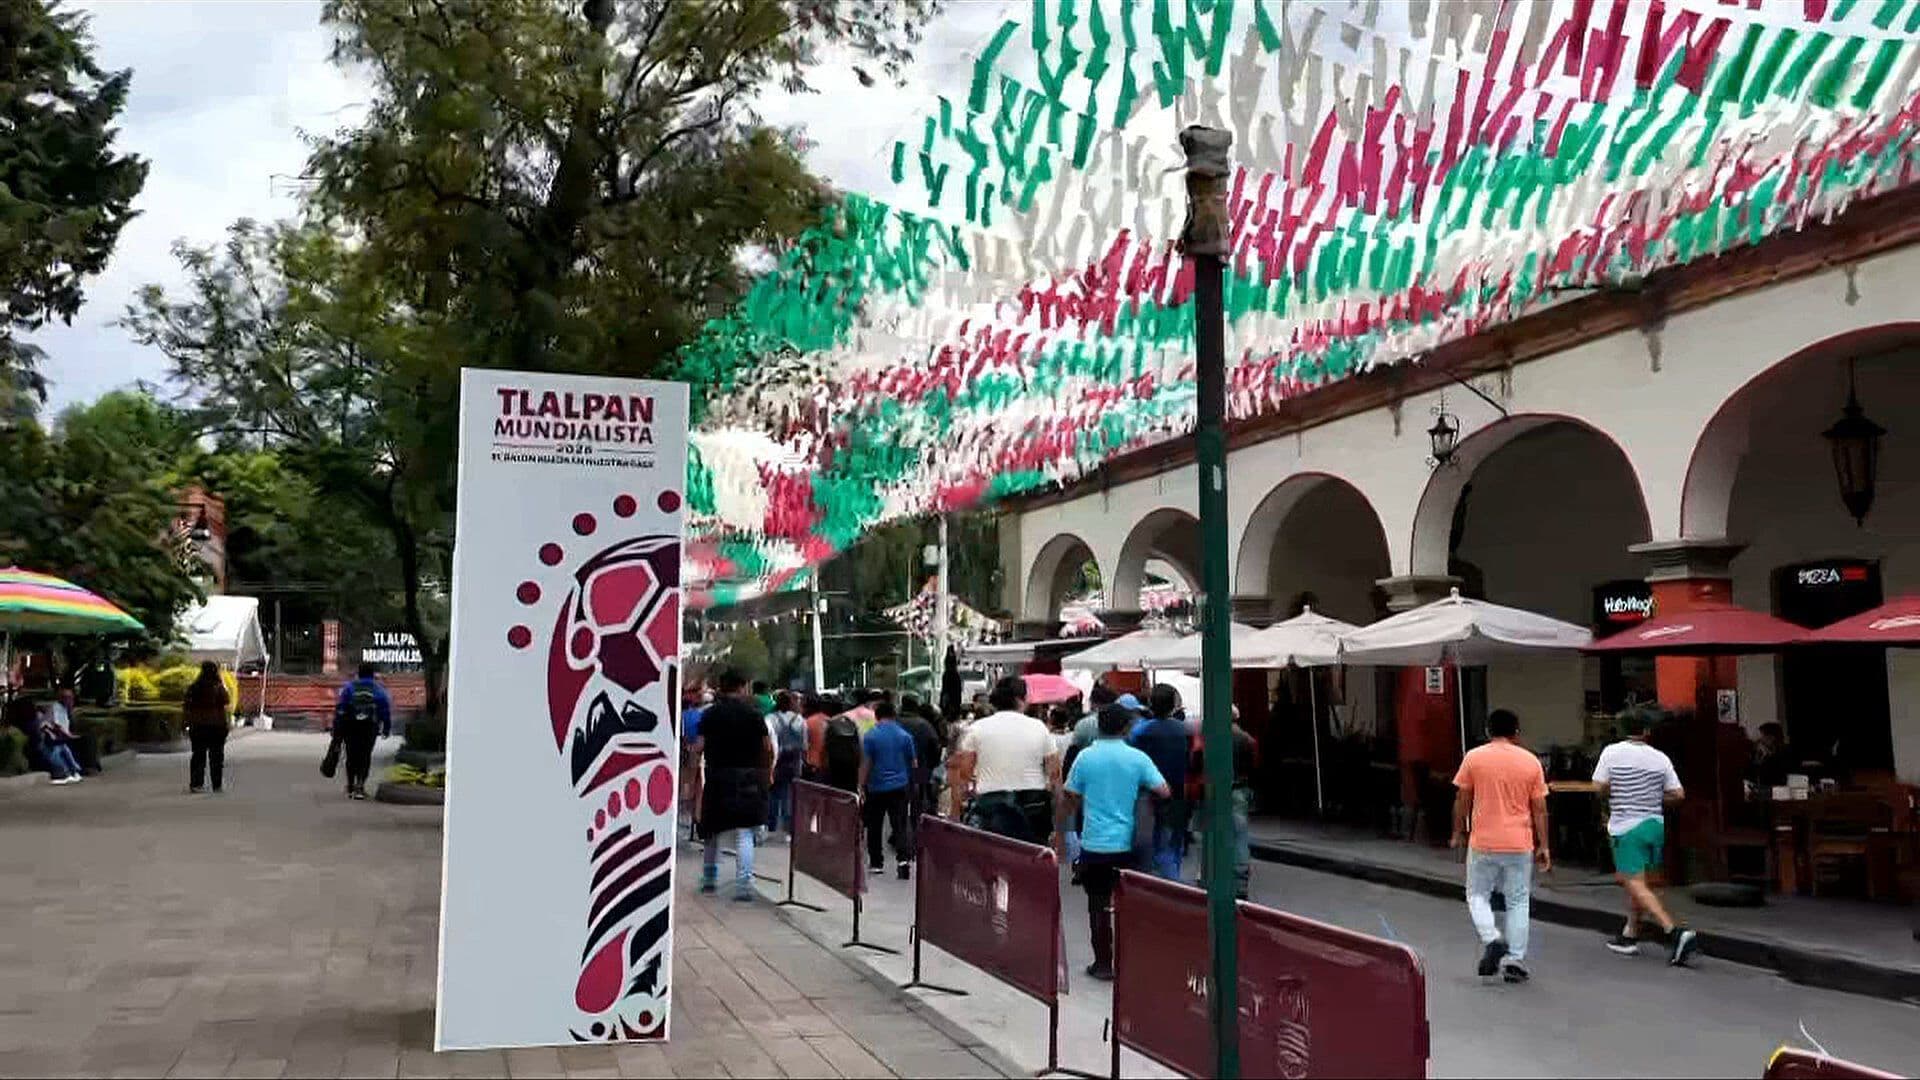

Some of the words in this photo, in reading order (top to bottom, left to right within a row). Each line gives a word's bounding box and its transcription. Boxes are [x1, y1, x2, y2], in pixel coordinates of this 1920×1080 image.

[497, 388, 655, 424] TLALPAN
[494, 418, 653, 445] MUNDIALISTA
[373, 632, 417, 646] TLALPA
